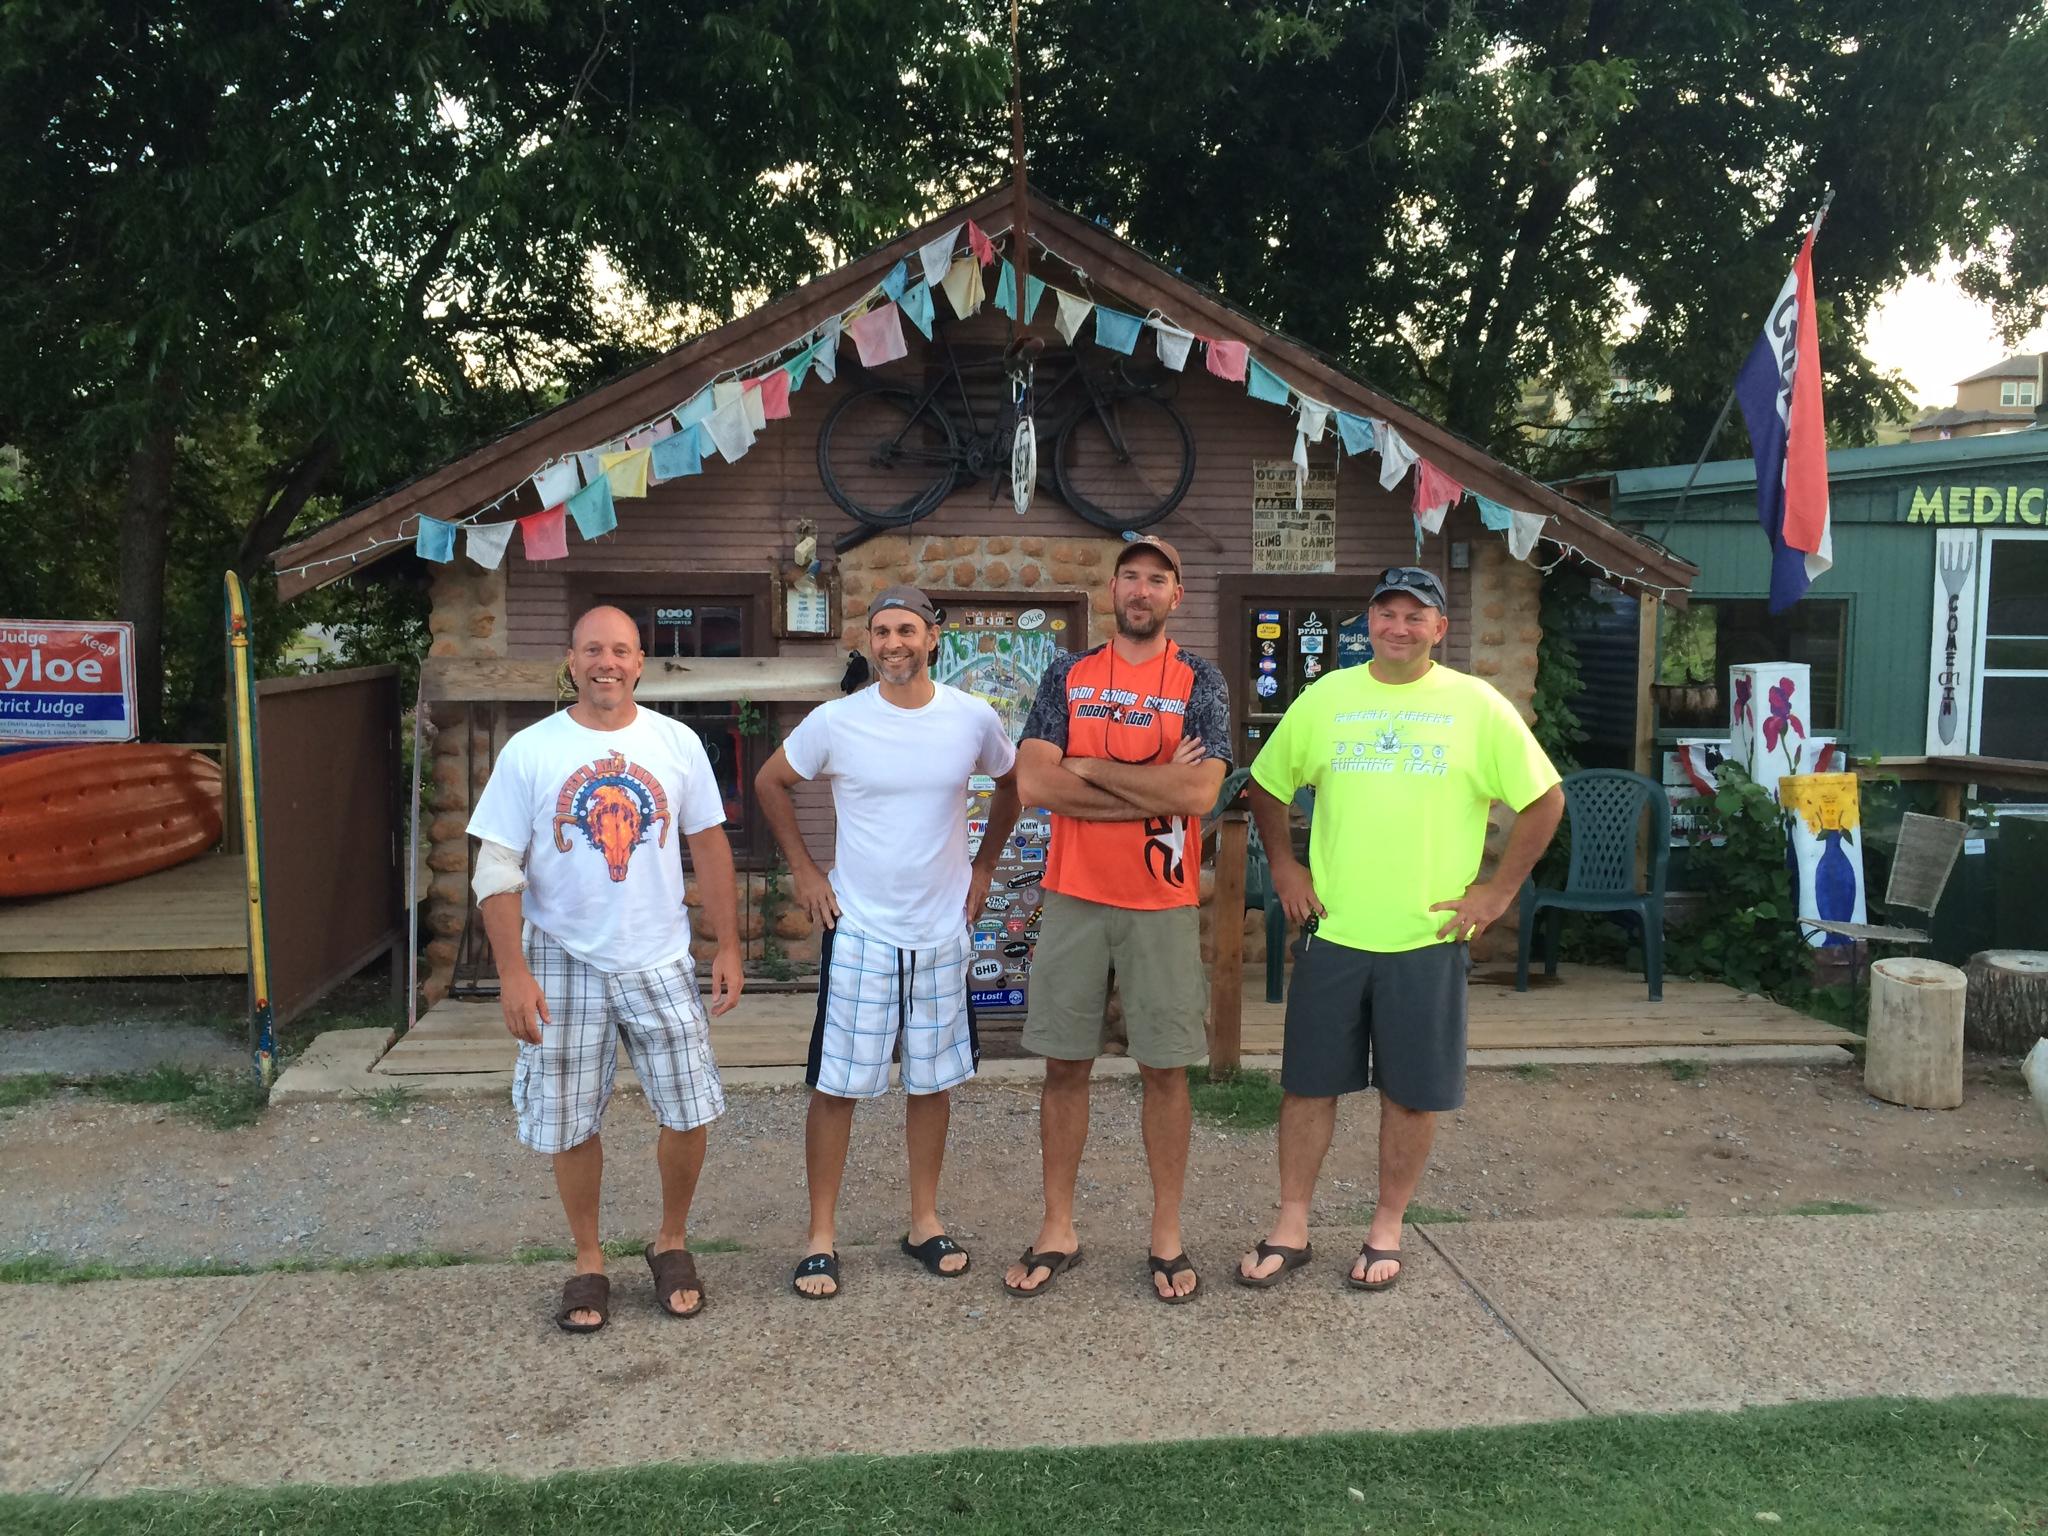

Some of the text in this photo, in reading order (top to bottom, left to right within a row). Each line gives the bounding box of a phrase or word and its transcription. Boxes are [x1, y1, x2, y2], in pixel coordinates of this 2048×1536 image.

[1256, 469, 1335, 481] OUTDORS
[1255, 534, 1282, 548] CLIMB
[1301, 537, 1334, 548] CAMP
[1019, 612, 1044, 627] Okie
[1297, 627, 1329, 637] prAna
[1339, 633, 1371, 643] Red Bu
[0, 630, 48, 647] Judge
[80, 633, 116, 657] Keep
[33, 698, 85, 718] Judge
[1076, 704, 1109, 720] moab
[1020, 822, 1038, 830] KMW
[975, 942, 995, 950] mhm
[975, 963, 998, 976] BHB
[982, 991, 1003, 1000] Lost!
